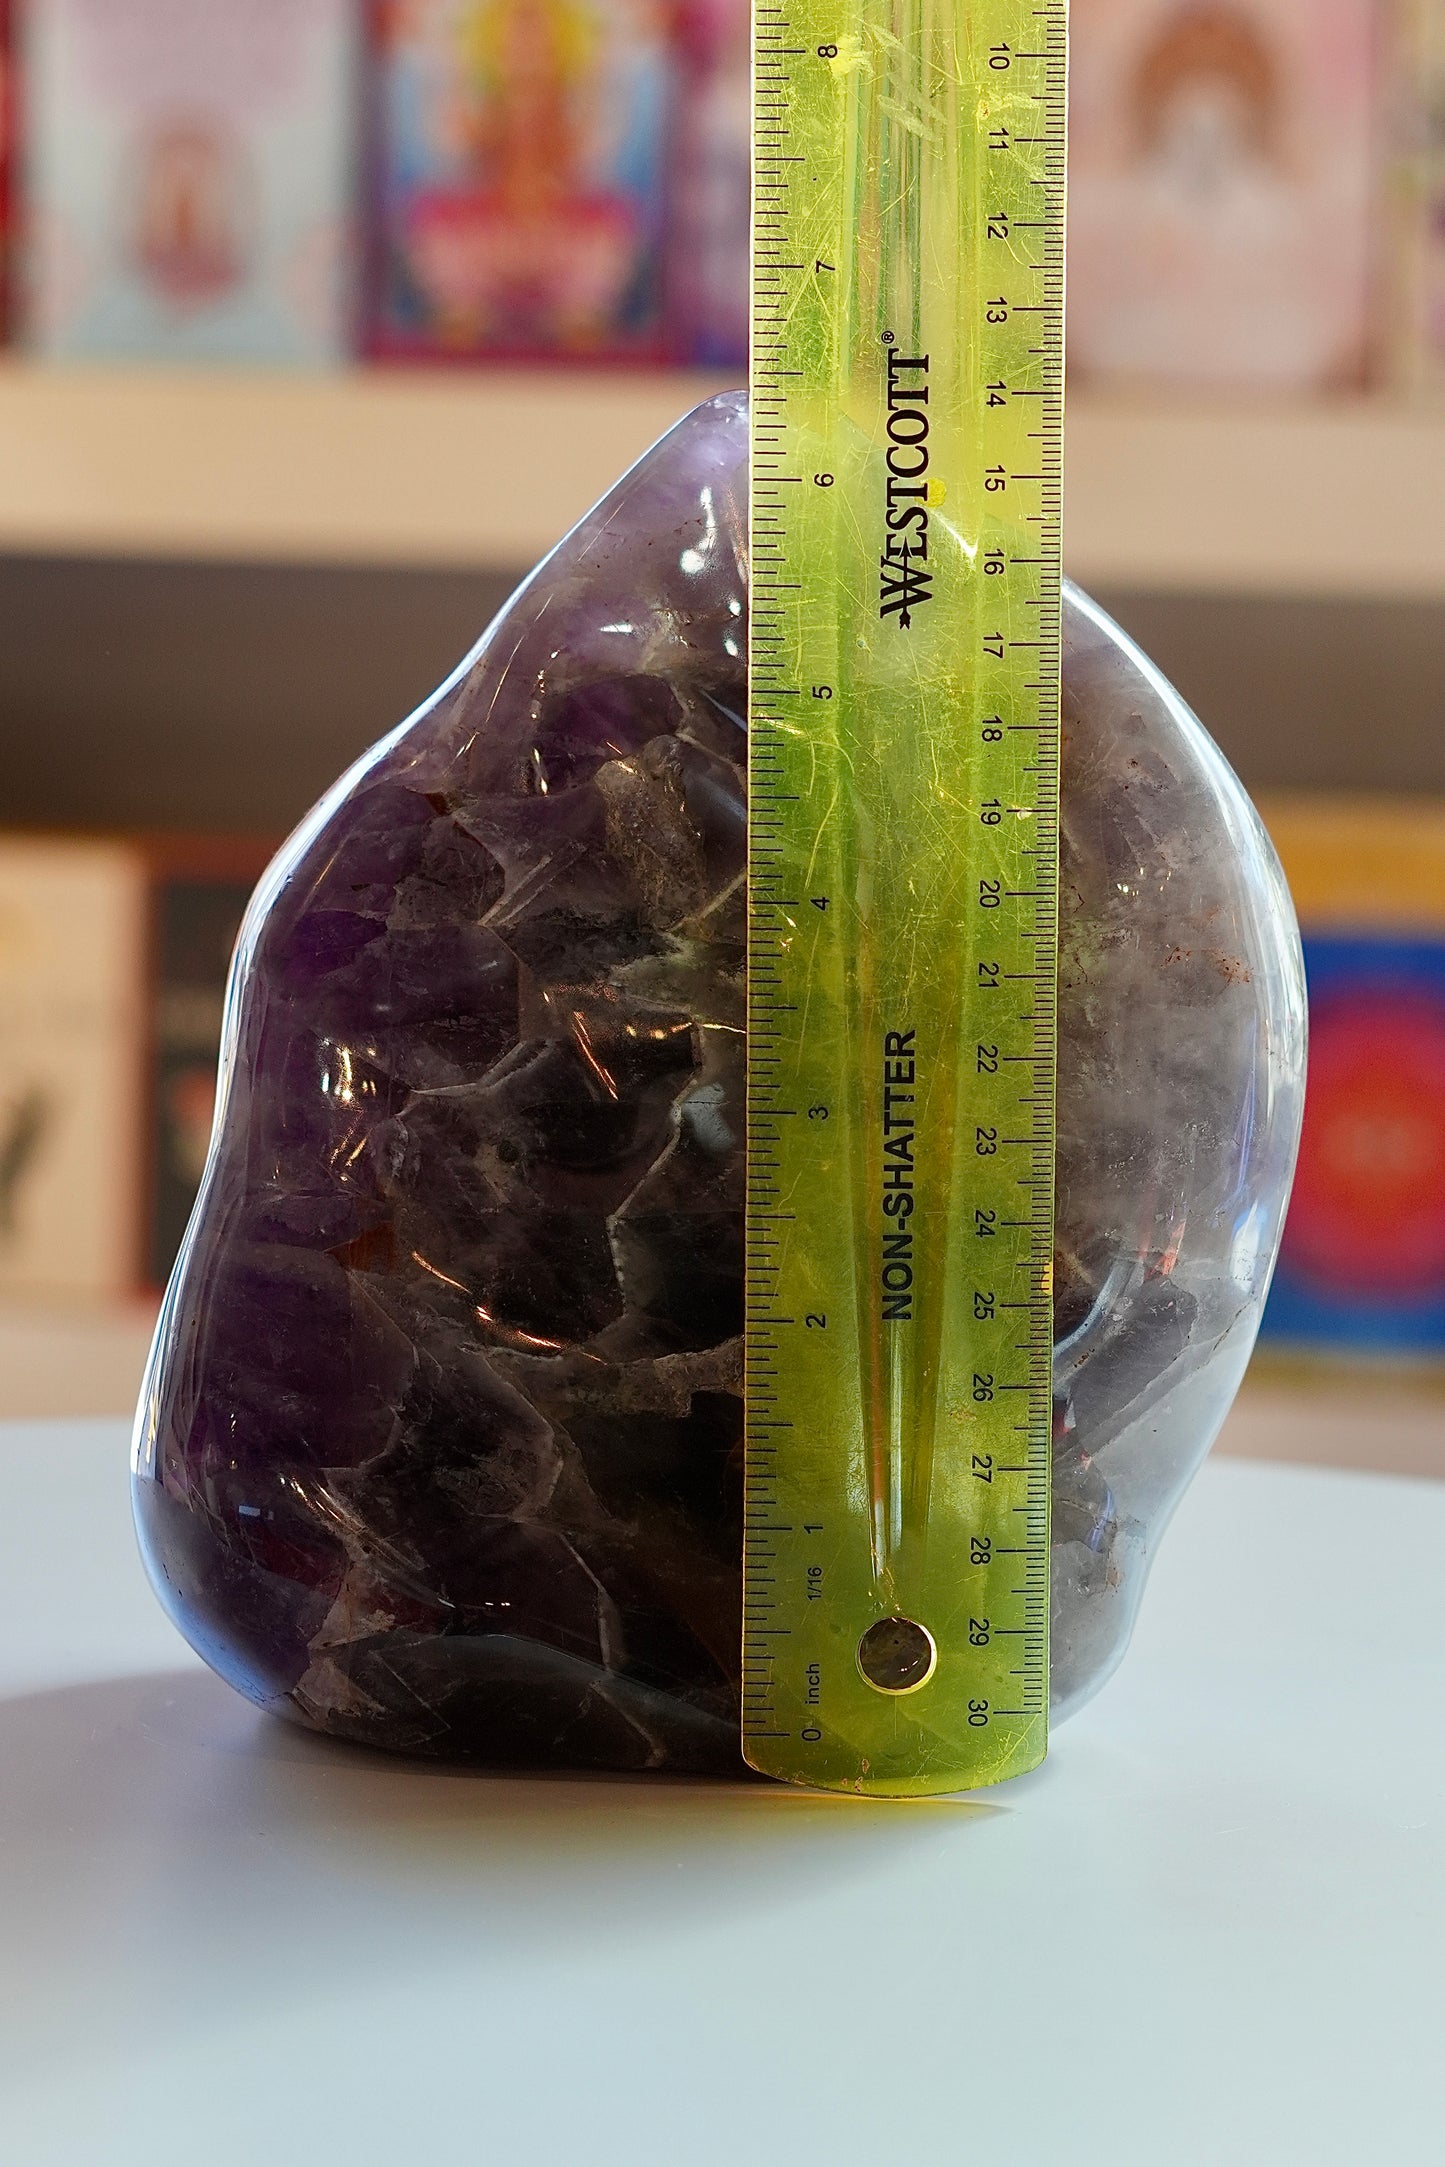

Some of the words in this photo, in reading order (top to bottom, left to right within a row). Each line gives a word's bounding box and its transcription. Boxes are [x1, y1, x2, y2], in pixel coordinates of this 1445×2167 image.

[817, 45, 839, 59] 8
[988, 43, 1011, 71] 10
[988, 128, 1011, 151] 11
[987, 213, 1010, 241] 12
[815, 260, 837, 275] 7
[986, 297, 1009, 326] 13
[985, 380, 1008, 409] 14
[813, 473, 835, 489] 6
[984, 464, 1007, 493] 15
[983, 549, 1006, 577] 16
[983, 631, 1005, 660] 17
[812, 685, 834, 700] 5
[981, 715, 1004, 744] 18
[980, 798, 1003, 828] 19
[810, 897, 831, 912] 4
[979, 880, 1002, 909] 20
[978, 962, 1001, 989] 21
[977, 1044, 1000, 1075] 22
[808, 1106, 830, 1121] 3
[976, 1128, 998, 1157] 23
[882, 1029, 917, 1321] NON-SHATTER
[974, 1210, 997, 1239] 24
[973, 1291, 995, 1321] 25
[806, 1314, 827, 1330] 2
[972, 1374, 995, 1403] 26
[971, 1455, 994, 1485] 27
[804, 1525, 824, 1535] 1
[970, 1537, 993, 1566] 28
[807, 1566, 824, 1602] 1/16
[968, 1618, 991, 1648] 29
[805, 1663, 822, 1706] inch
[967, 1699, 990, 1728] 30
[801, 1727, 823, 1743] 0
